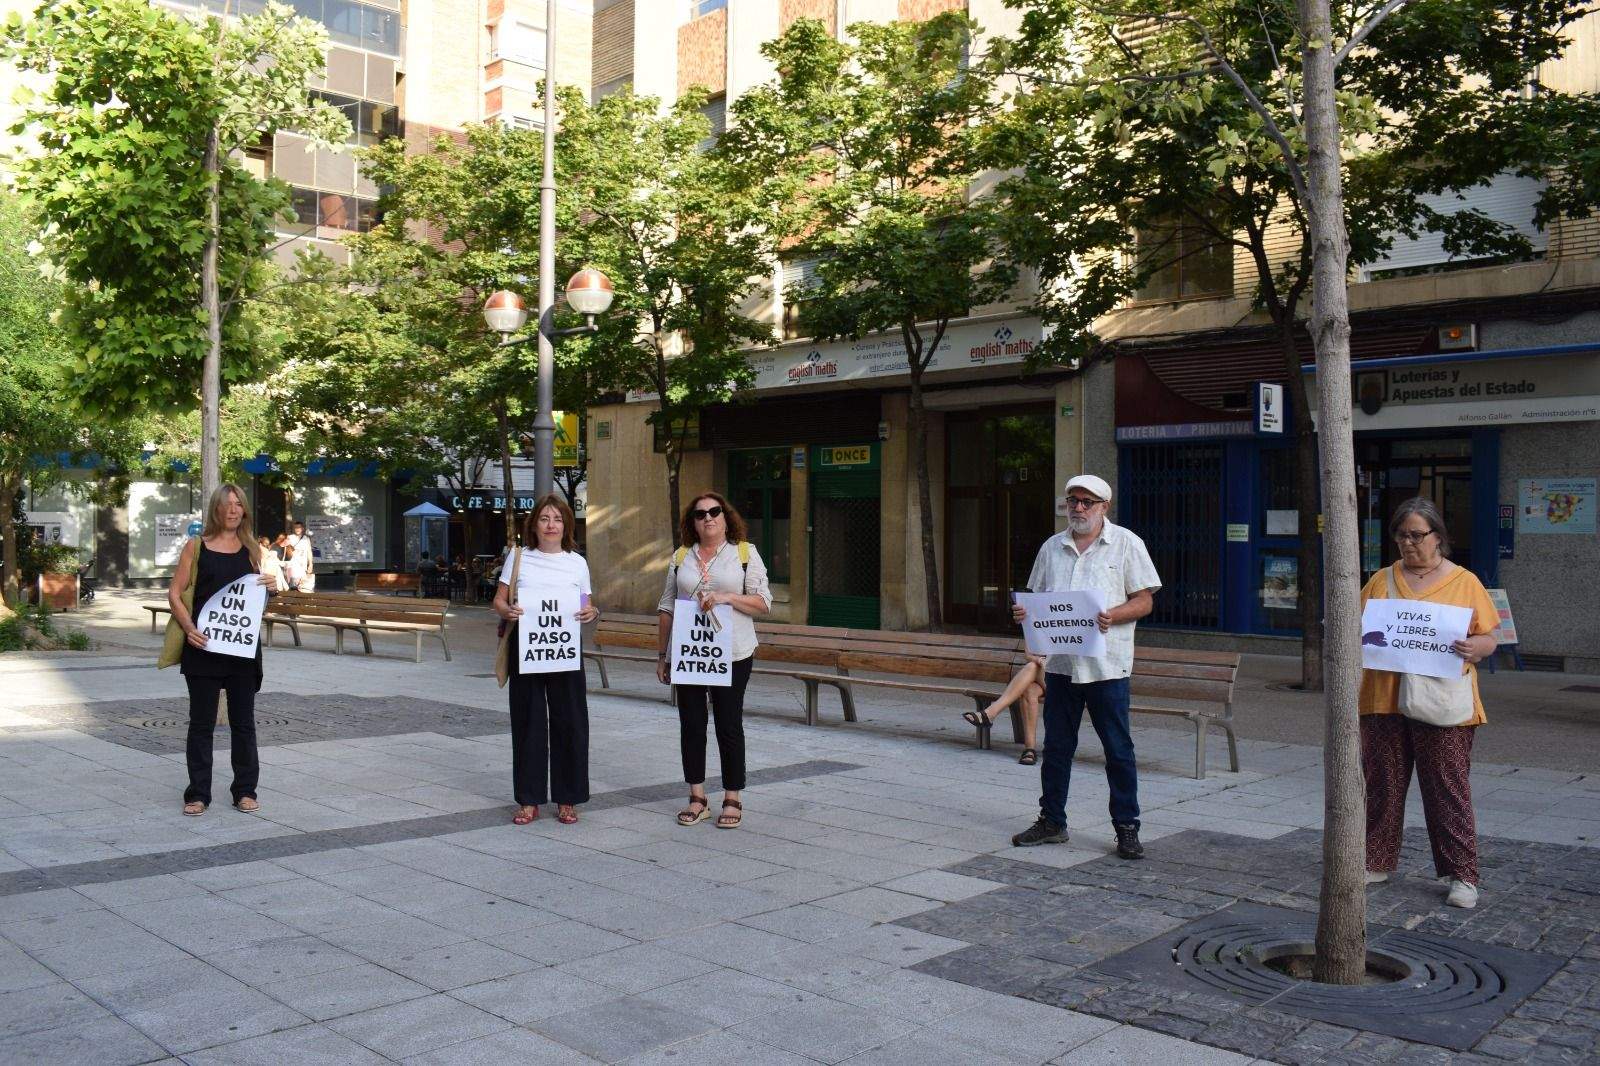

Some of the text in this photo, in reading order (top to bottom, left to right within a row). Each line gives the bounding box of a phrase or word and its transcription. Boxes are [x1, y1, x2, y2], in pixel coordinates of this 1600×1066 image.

[970, 338, 1034, 364] english maths
[789, 361, 837, 383] english maths
[1392, 368, 1461, 384] Loterías y
[1391, 379, 1537, 403] Apuestas del Estado
[1458, 412, 1488, 423] Alfonso
[1175, 425, 1184, 436] Y
[1191, 421, 1251, 435] PRIMITIVA
[835, 449, 867, 462] ONCE
[228, 583, 246, 596] NI
[221, 597, 246, 611] UN
[541, 599, 559, 612] NI
[1049, 603, 1074, 613] NOS
[208, 610, 252, 628] PASO
[538, 615, 562, 628] UN
[694, 613, 711, 627] NI
[1033, 618, 1095, 629] QUEREMOS
[1396, 611, 1432, 622] VIVAS
[203, 627, 254, 646] ATRÁS
[528, 631, 572, 644] PASO
[690, 629, 714, 643] UN
[1386, 624, 1437, 637] Y LIBRES
[1050, 635, 1083, 644] VIVAS
[1391, 638, 1457, 654] QUEREMOS
[524, 644, 577, 662] ATRÁS
[680, 644, 723, 658] PASO
[676, 659, 728, 675] ATRÁS
